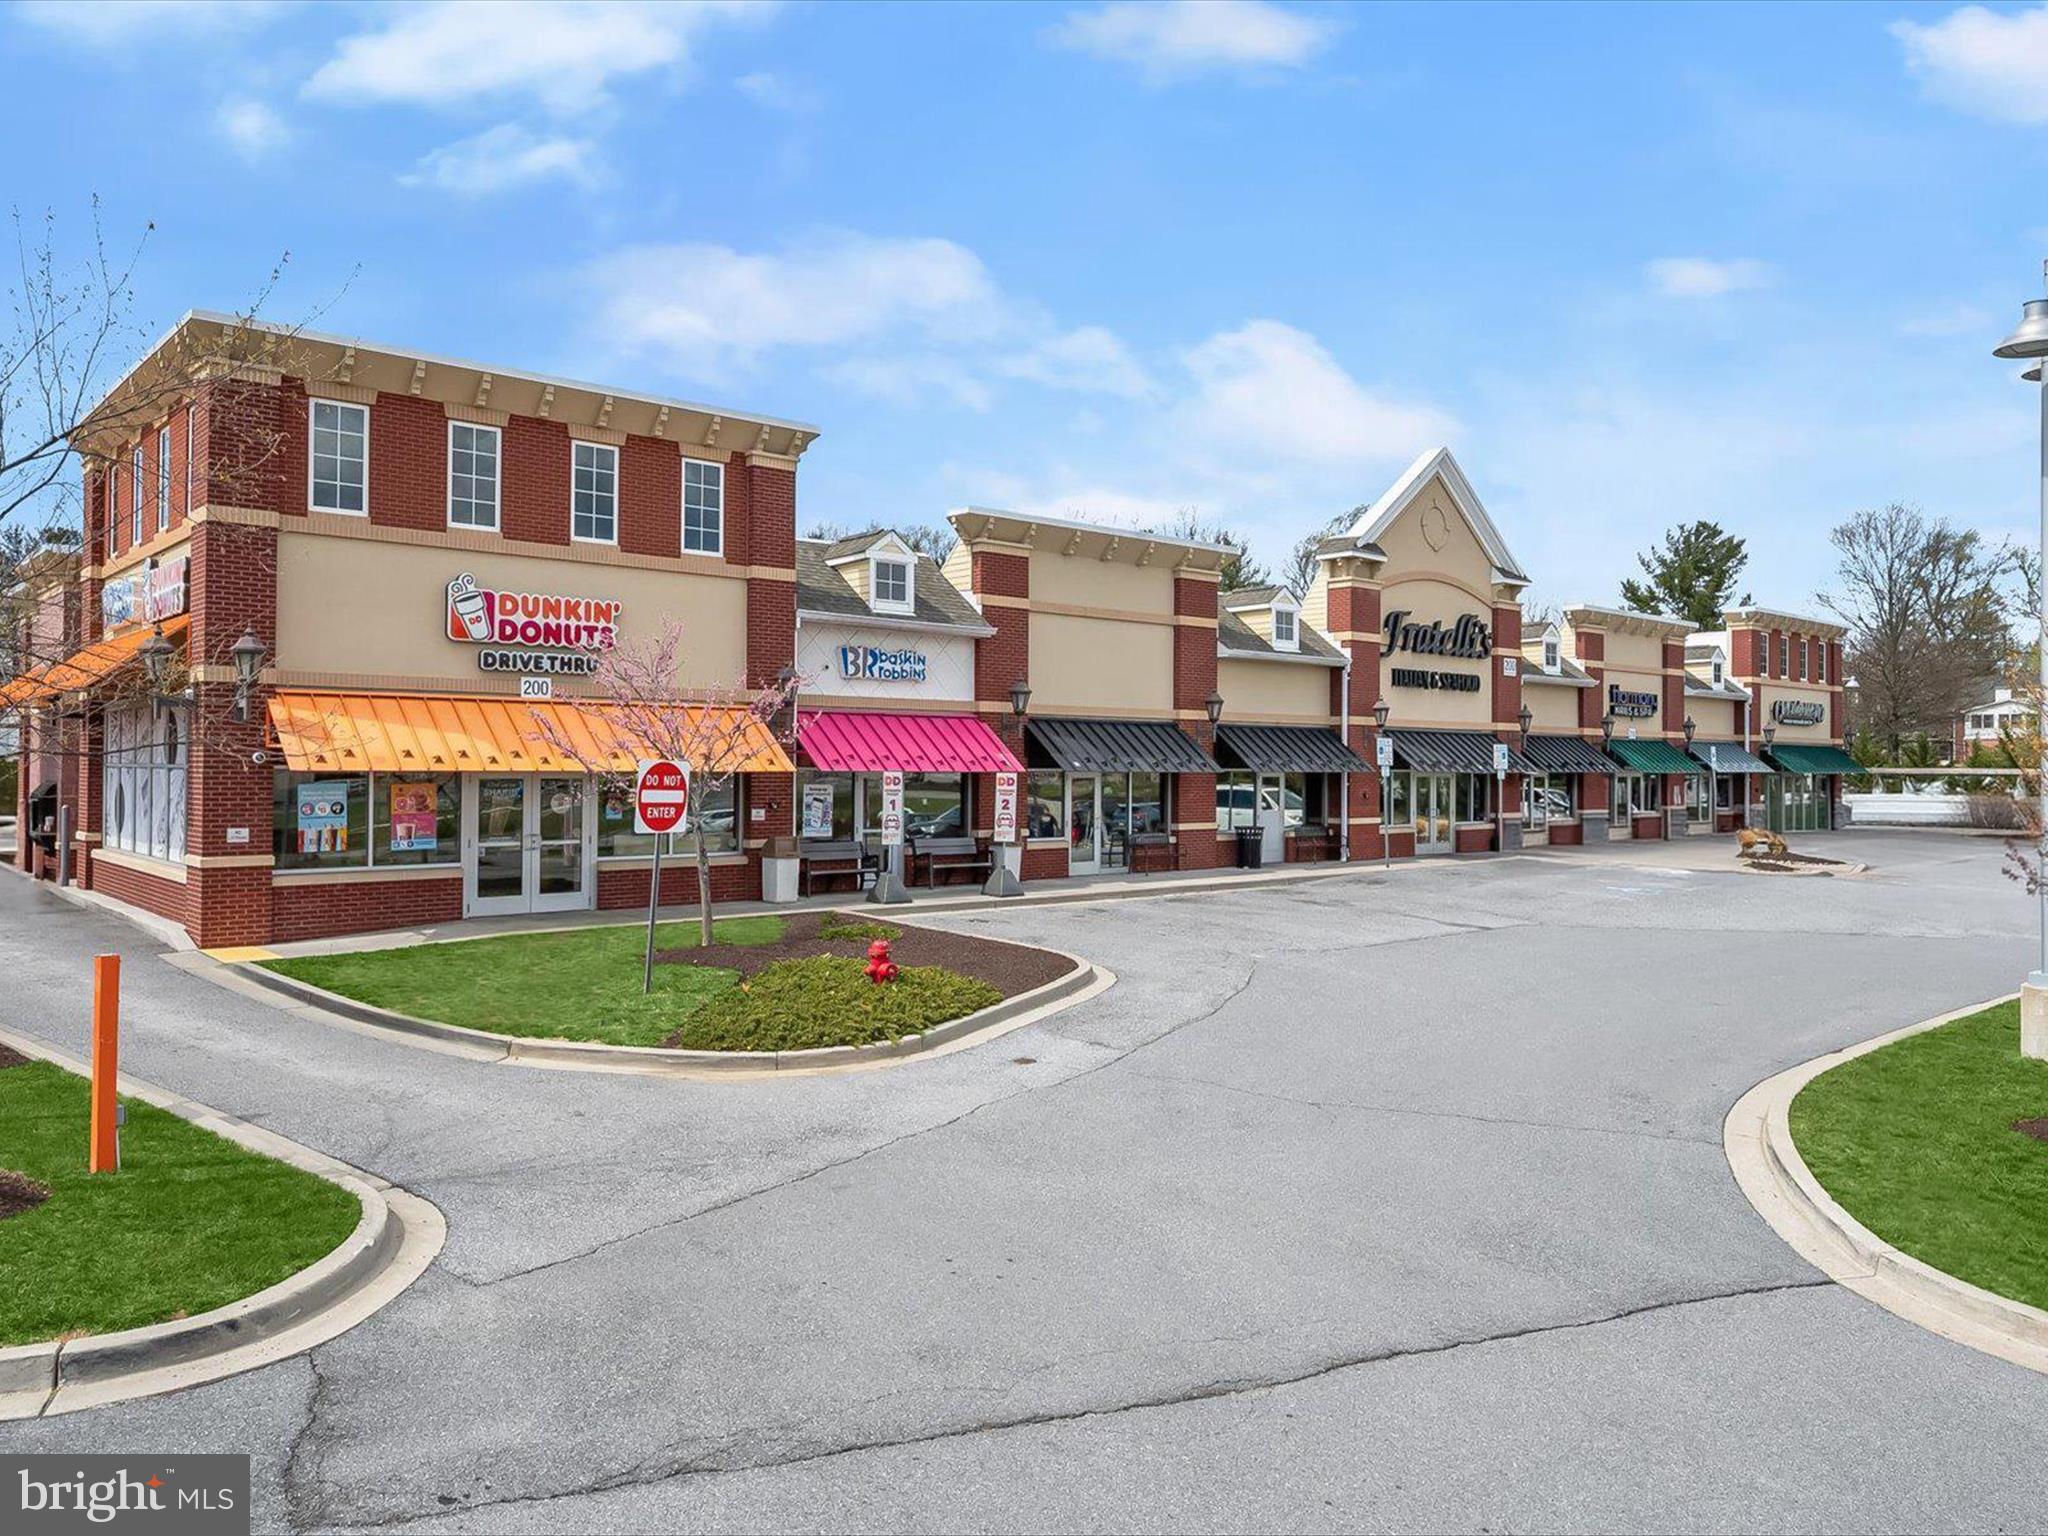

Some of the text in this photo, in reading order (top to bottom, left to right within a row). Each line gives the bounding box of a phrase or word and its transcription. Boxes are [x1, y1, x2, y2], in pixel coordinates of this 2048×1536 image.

[498, 592, 622, 626] DUNKIN'
[498, 618, 614, 650] DONUTS
[1379, 610, 1493, 660] Fratelli's
[842, 647, 879, 678] BR
[879, 649, 926, 667] baskin
[879, 667, 926, 681] robbins
[523, 680, 548, 696] 200
[646, 775, 682, 786] DO NOT
[885, 776, 901, 787] DD
[998, 777, 1015, 787] DD
[889, 799, 896, 811] 1
[1001, 799, 1010, 811] 2
[646, 807, 676, 819] ENTER
